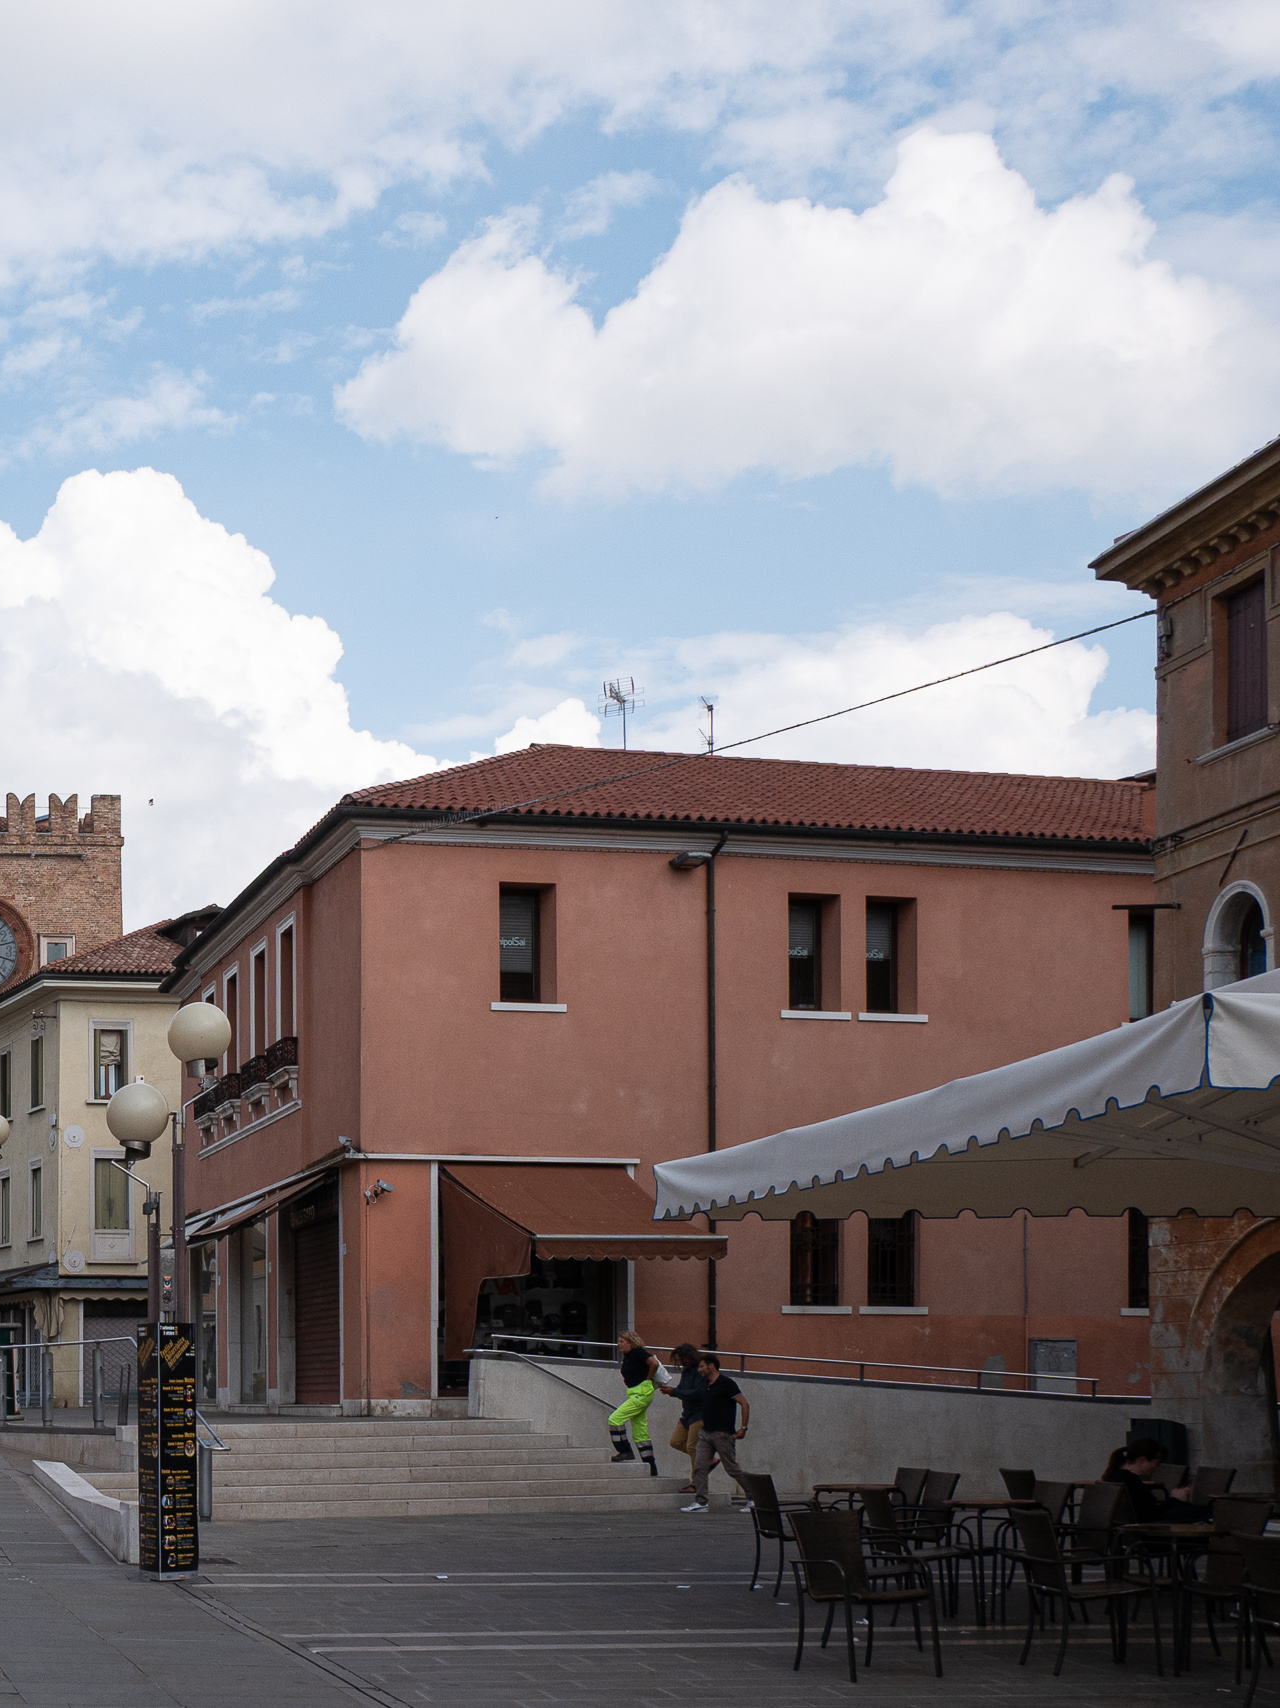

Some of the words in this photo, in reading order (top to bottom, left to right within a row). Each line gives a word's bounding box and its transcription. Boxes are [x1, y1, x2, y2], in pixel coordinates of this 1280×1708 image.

[0, 931, 7, 942] 2
[6, 946, 12, 957] 3
[0, 960, 7, 971] 4
